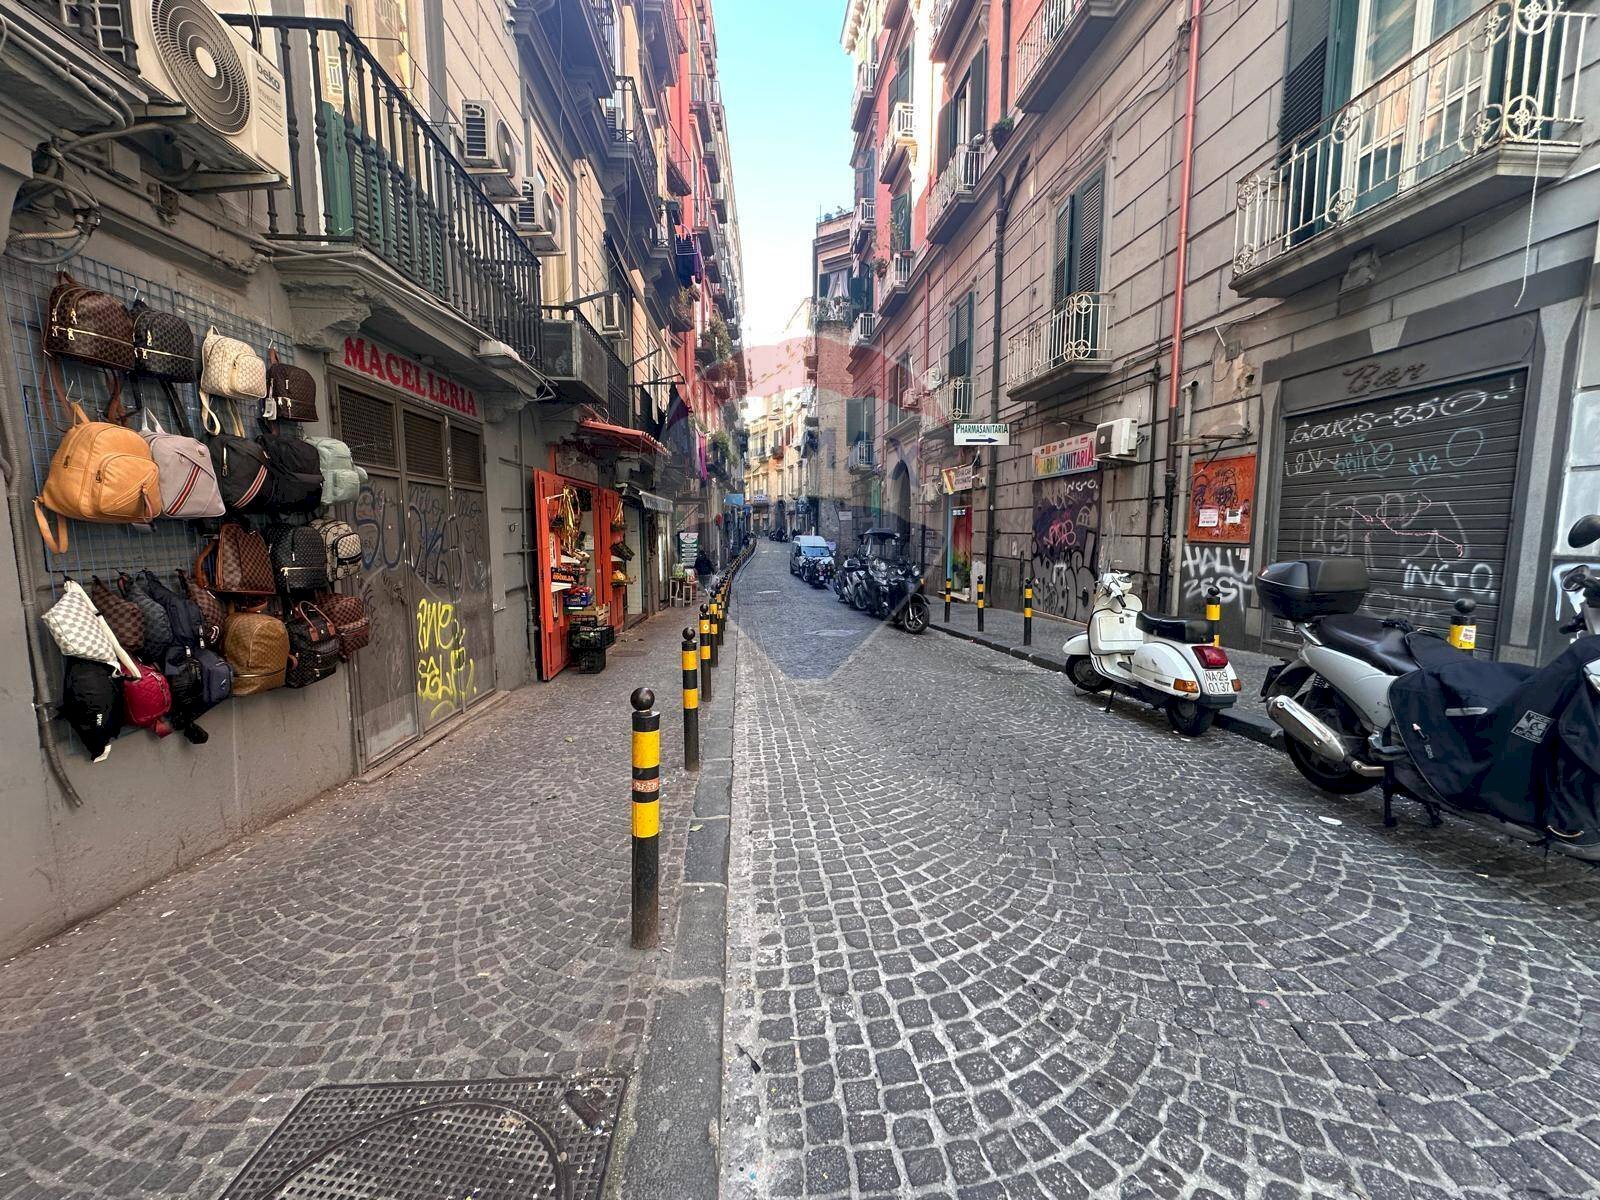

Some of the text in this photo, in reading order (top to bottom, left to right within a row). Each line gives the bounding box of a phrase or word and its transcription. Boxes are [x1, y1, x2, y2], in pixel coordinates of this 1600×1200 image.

[344, 335, 477, 417] MACELLERIA
[955, 423, 1009, 434] PHARMASANITARIA
[1205, 671, 1229, 682] NA 29
[1208, 682, 1230, 692] 0137
